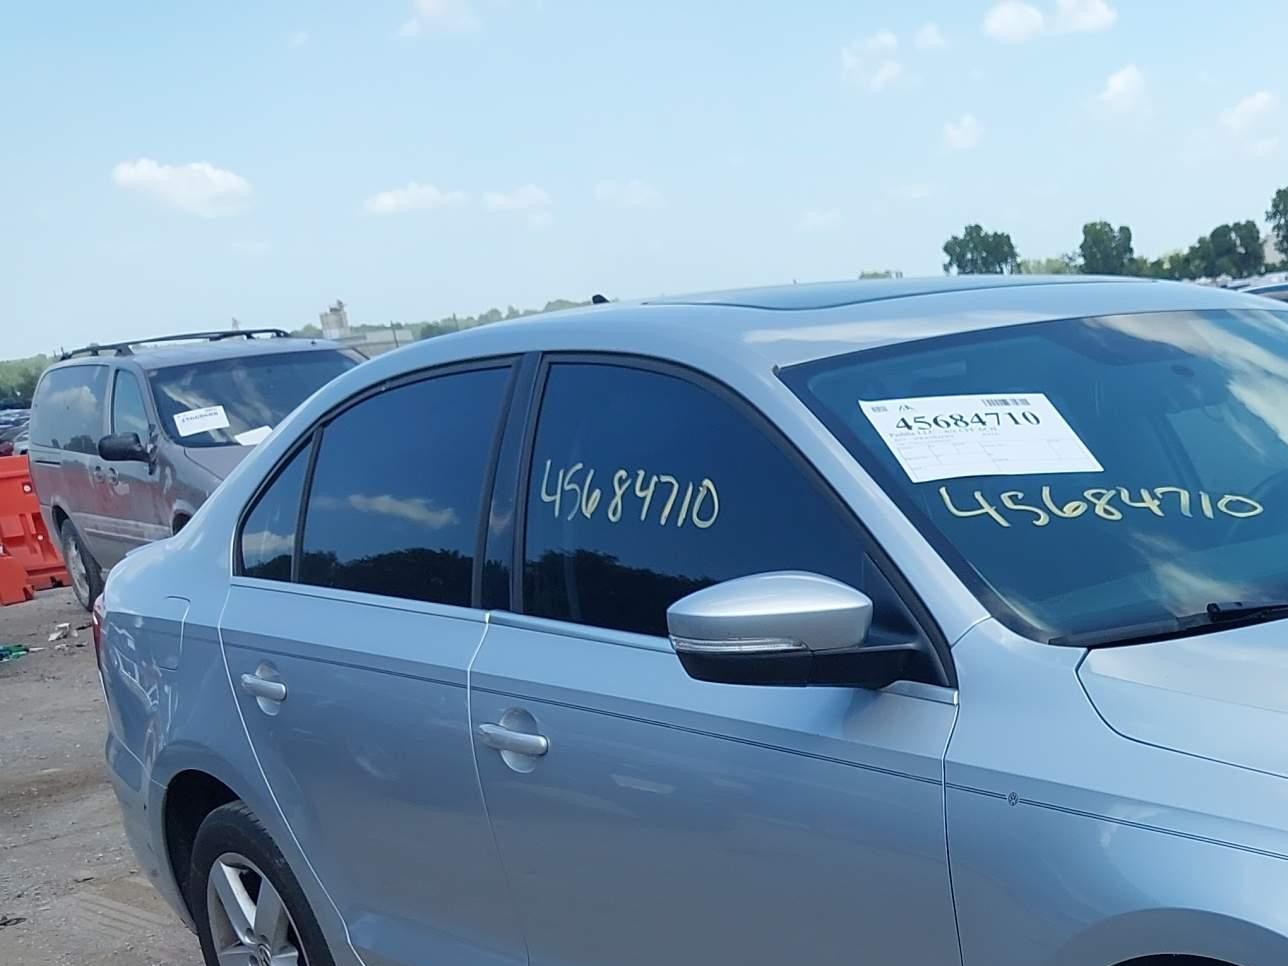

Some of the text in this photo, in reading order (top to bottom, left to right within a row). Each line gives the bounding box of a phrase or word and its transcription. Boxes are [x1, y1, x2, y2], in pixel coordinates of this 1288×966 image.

[895, 410, 1041, 431] 45684710
[541, 459, 719, 528] 45684710
[939, 486, 1264, 528] 45684710
